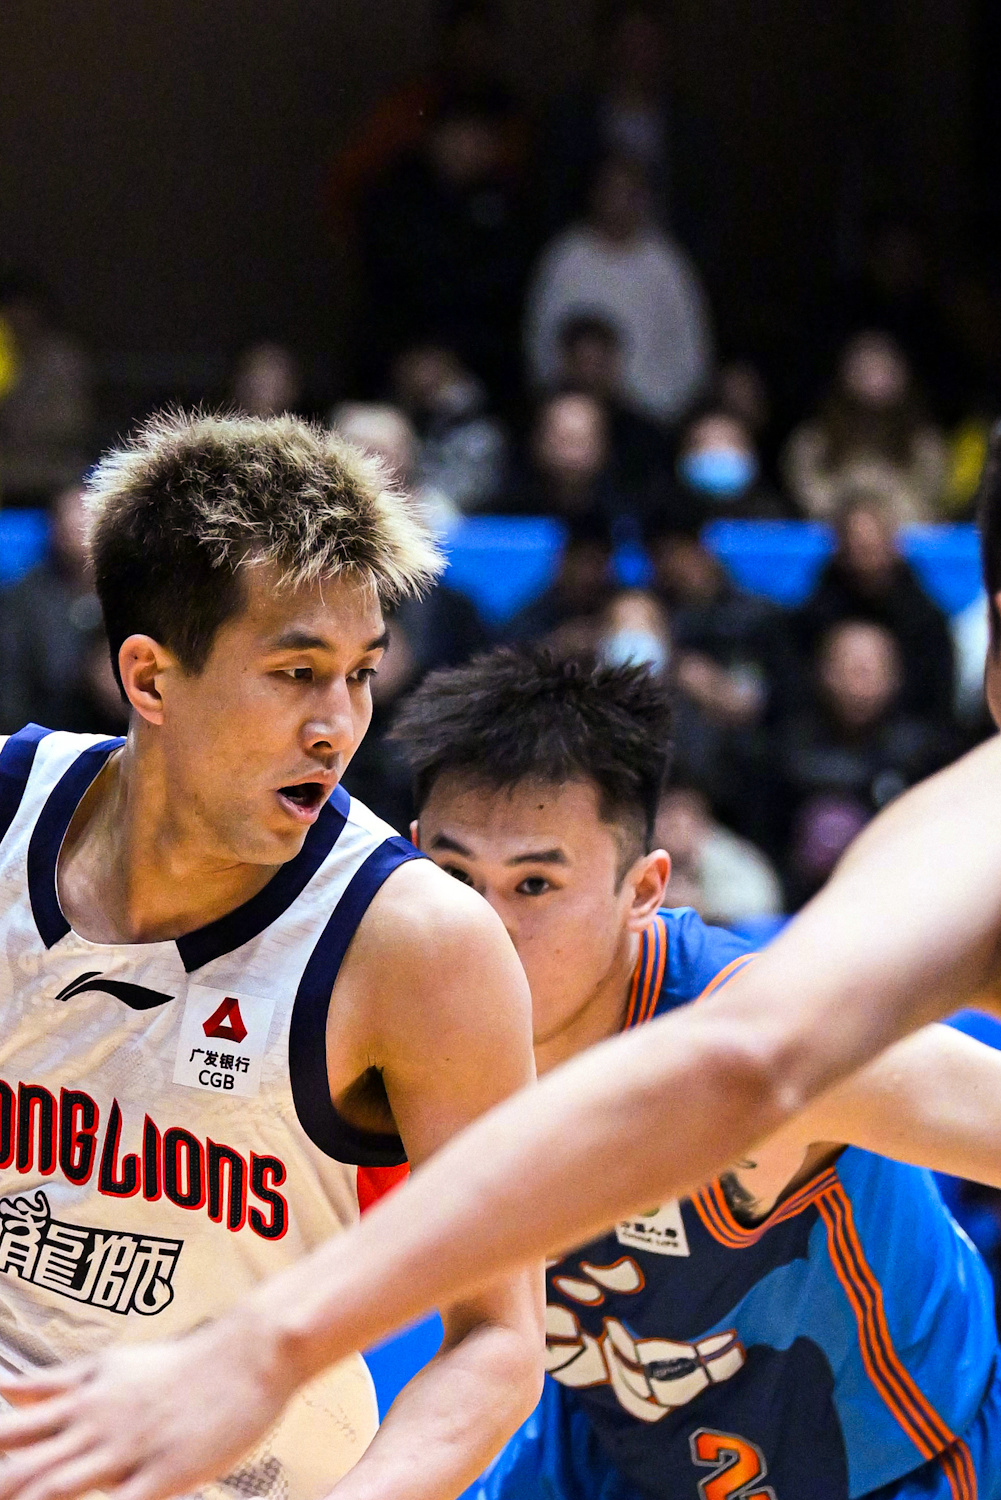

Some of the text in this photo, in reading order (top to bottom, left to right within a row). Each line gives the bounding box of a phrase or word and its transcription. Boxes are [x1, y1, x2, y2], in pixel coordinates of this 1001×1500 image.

[189, 1048, 250, 1073] 广发银行
[199, 1070, 235, 1090] CGB
[98, 1097, 289, 1241] LIONS
